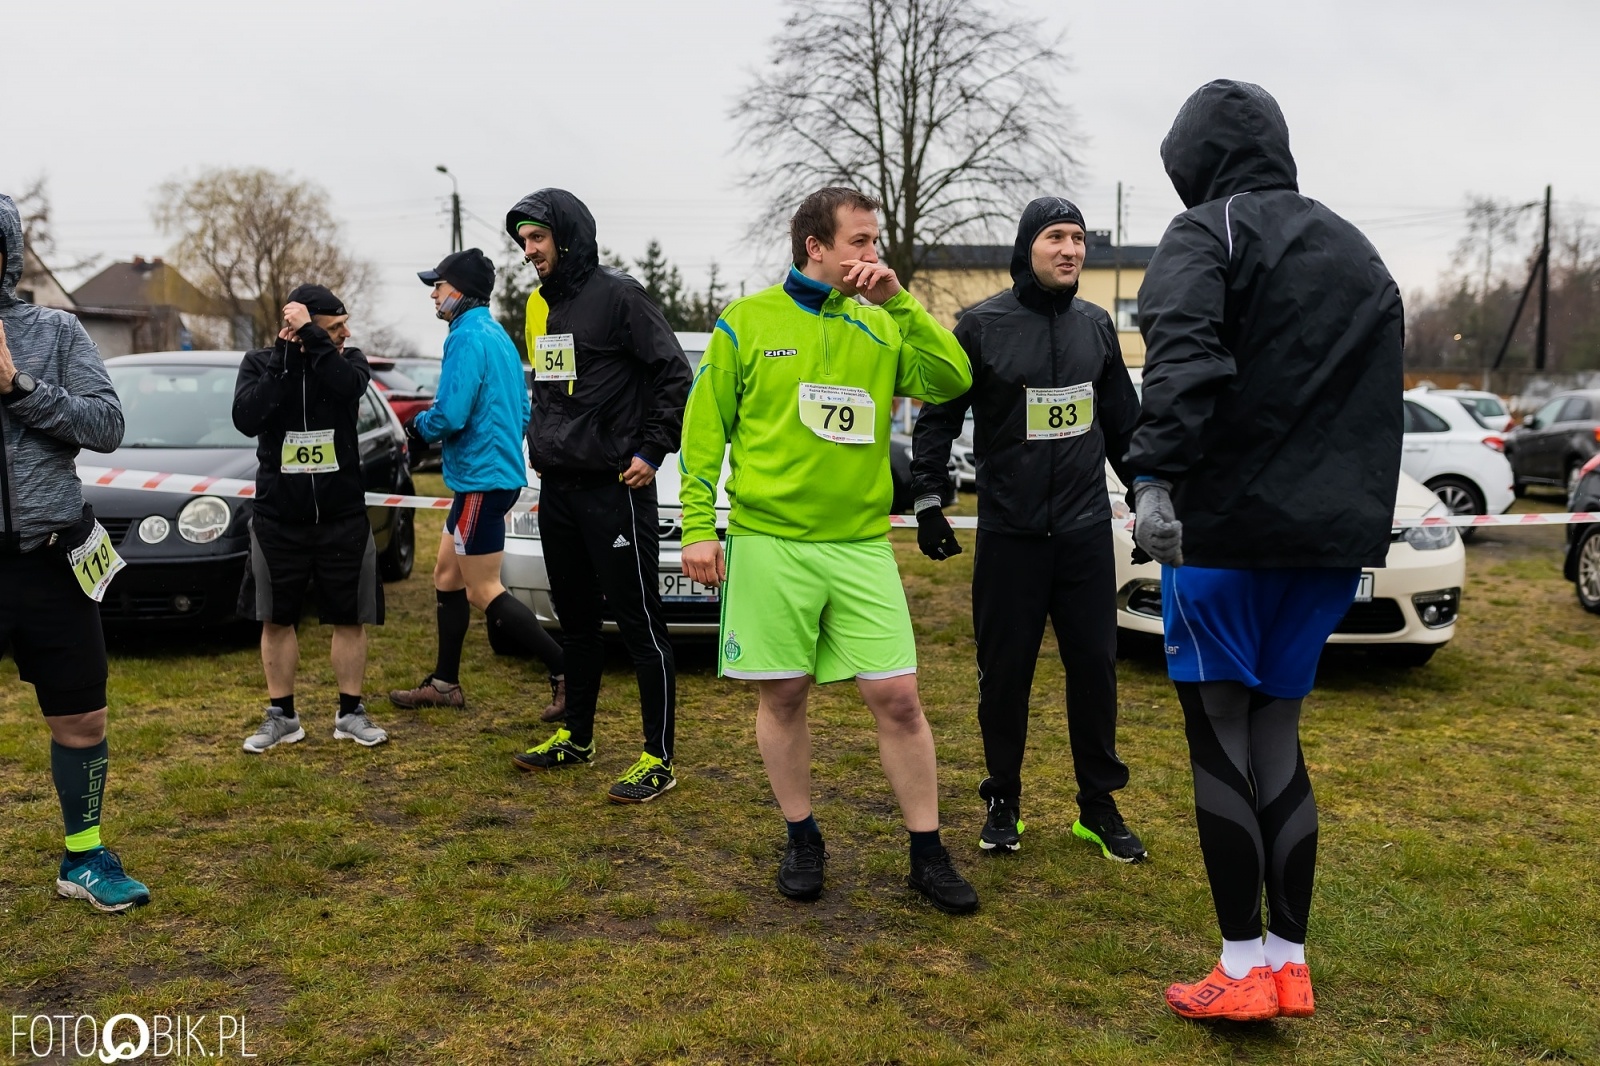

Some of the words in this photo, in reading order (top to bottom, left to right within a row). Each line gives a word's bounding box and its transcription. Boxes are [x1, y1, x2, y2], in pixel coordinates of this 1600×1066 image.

[545, 350, 564, 370] 54
[821, 404, 854, 432] 79
[1048, 403, 1078, 428] 83
[296, 445, 323, 464] 65
[82, 543, 110, 585] 119
